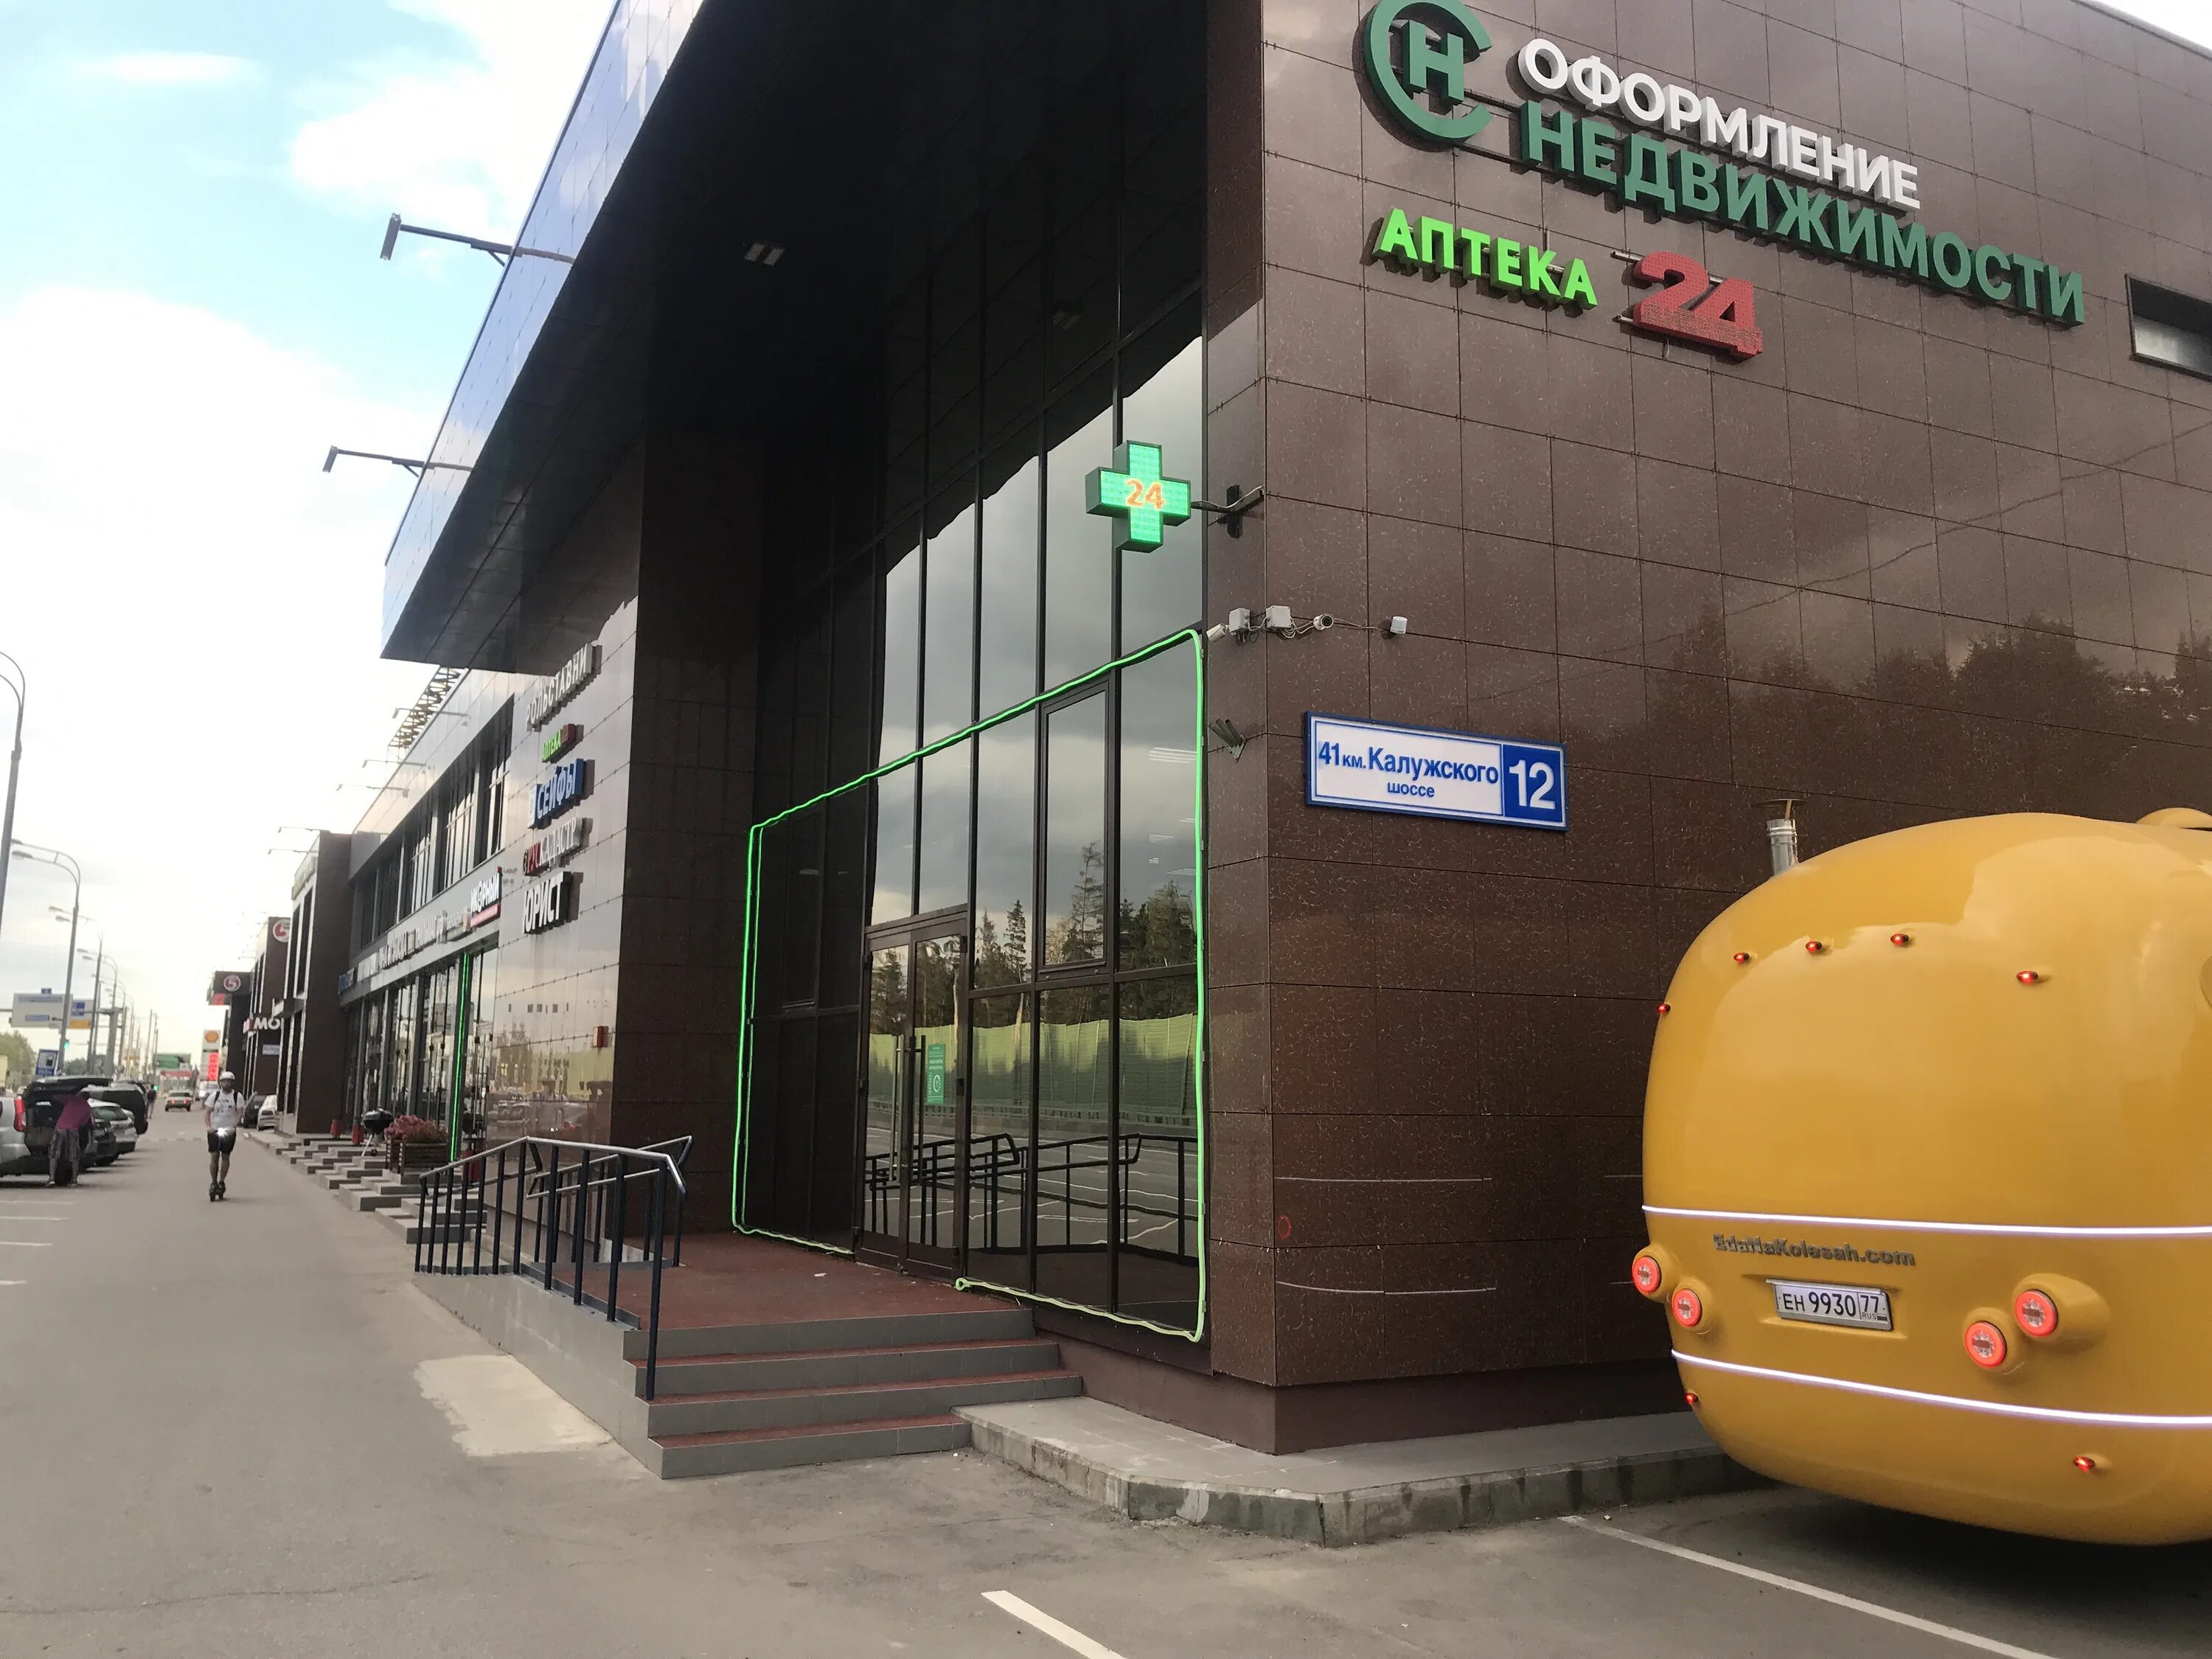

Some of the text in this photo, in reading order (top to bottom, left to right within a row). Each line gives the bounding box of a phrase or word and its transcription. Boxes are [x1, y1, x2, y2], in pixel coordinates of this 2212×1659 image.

[1516, 38, 1920, 212] ОФОРМЛЕНИЕ
[1519, 100, 2085, 330] НЕДВИЖИМОСТИ
[1374, 207, 1764, 362] АПТЕКА 24
[1125, 479, 1165, 510] 24
[525, 643, 589, 731] РОЛЬСТАВНИ
[1318, 741, 1499, 785] 41 км. Калужского
[1509, 759, 1556, 810] 12
[536, 759, 578, 819] СЕЙФЫ
[1387, 781, 1435, 798] шоссе
[522, 872, 565, 934] ЮРИСТ
[1713, 1233, 1916, 1266] EdaNaKolesah.com
[1809, 1291, 1856, 1317] 9930
[1860, 1295, 1879, 1313] 77
[1862, 1312, 1877, 1320] RUS
